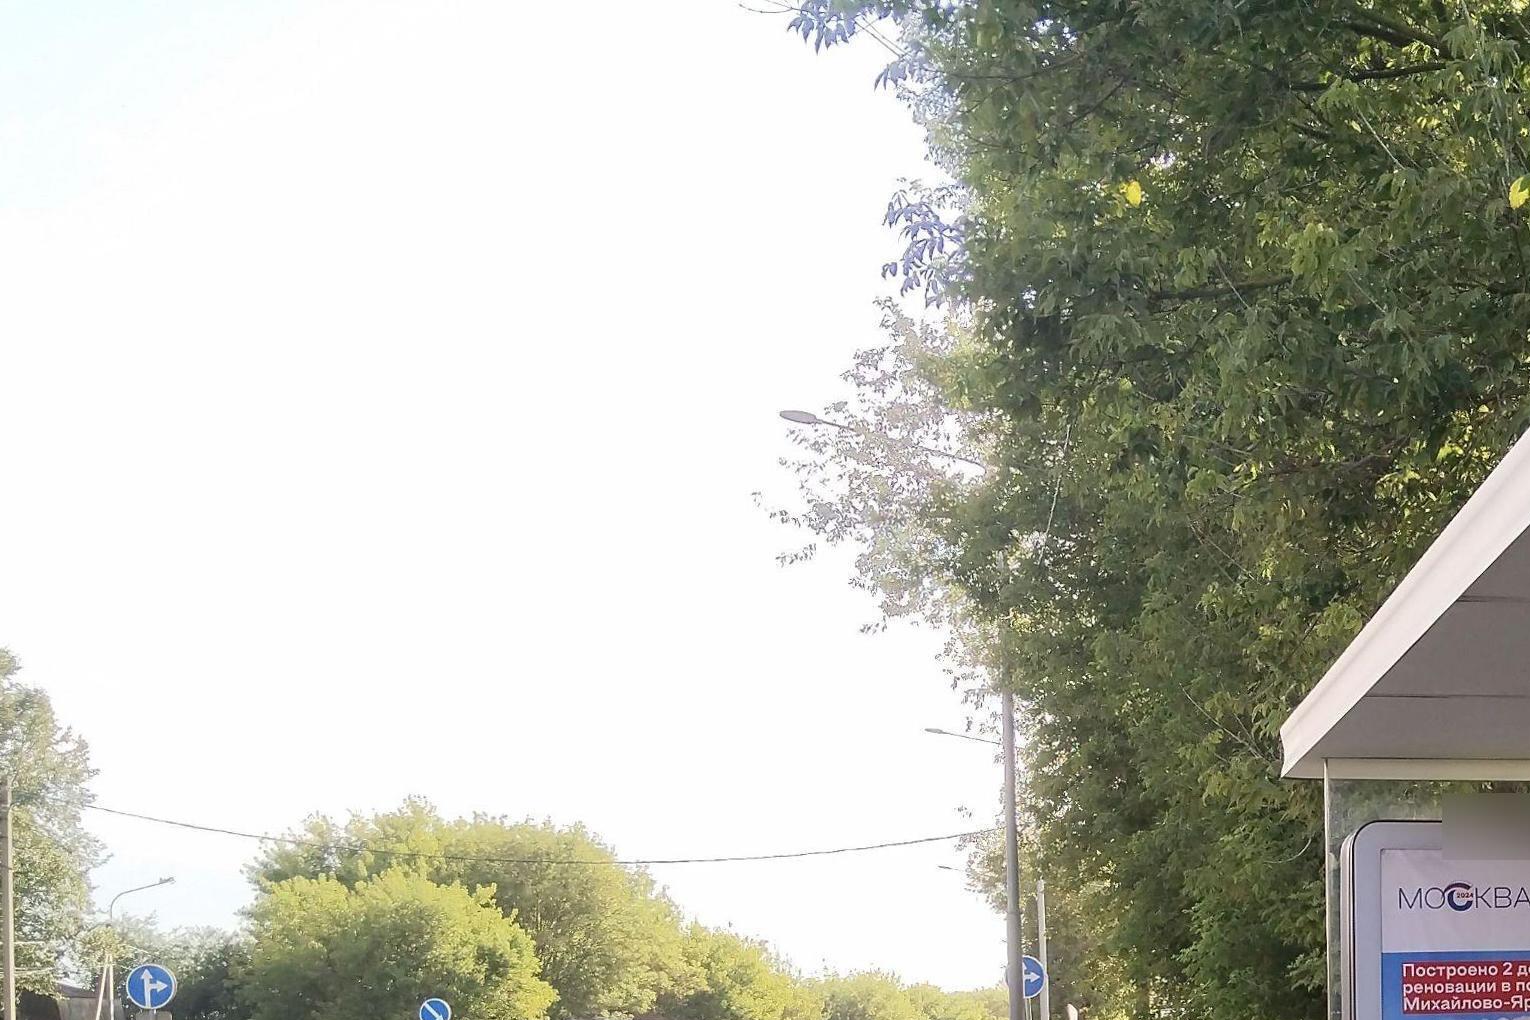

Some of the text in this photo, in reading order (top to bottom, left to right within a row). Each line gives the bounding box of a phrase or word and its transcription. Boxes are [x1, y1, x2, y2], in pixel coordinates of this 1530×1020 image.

[1402, 963, 1499, 980] Построено
[1502, 962, 1513, 976] 2
[1402, 981, 1497, 997] реновации
[1501, 982, 1511, 992] в
